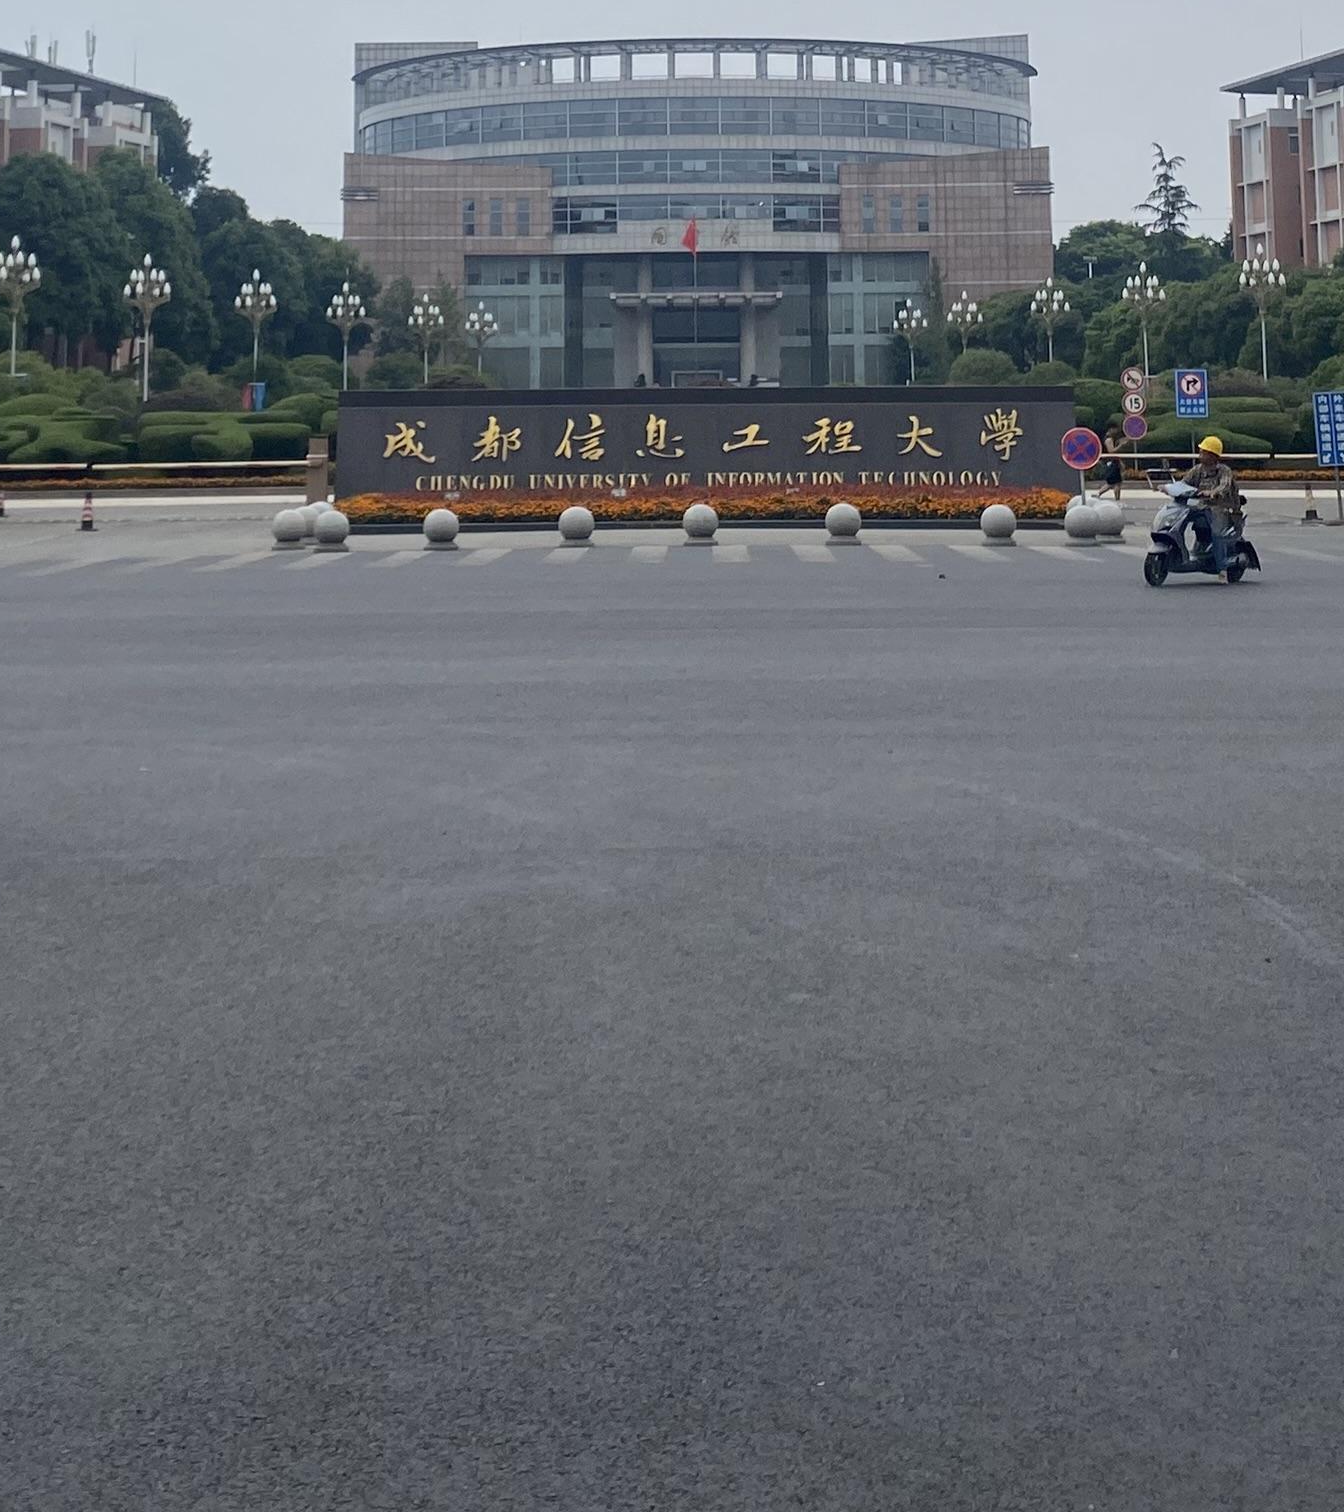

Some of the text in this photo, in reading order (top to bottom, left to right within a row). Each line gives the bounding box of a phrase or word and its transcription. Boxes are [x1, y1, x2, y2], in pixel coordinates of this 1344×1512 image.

[1129, 397, 1141, 410] 15
[415, 470, 1002, 492] CHENGDU UNIVERSITY OF INFORMATION TECHNOLOGY
